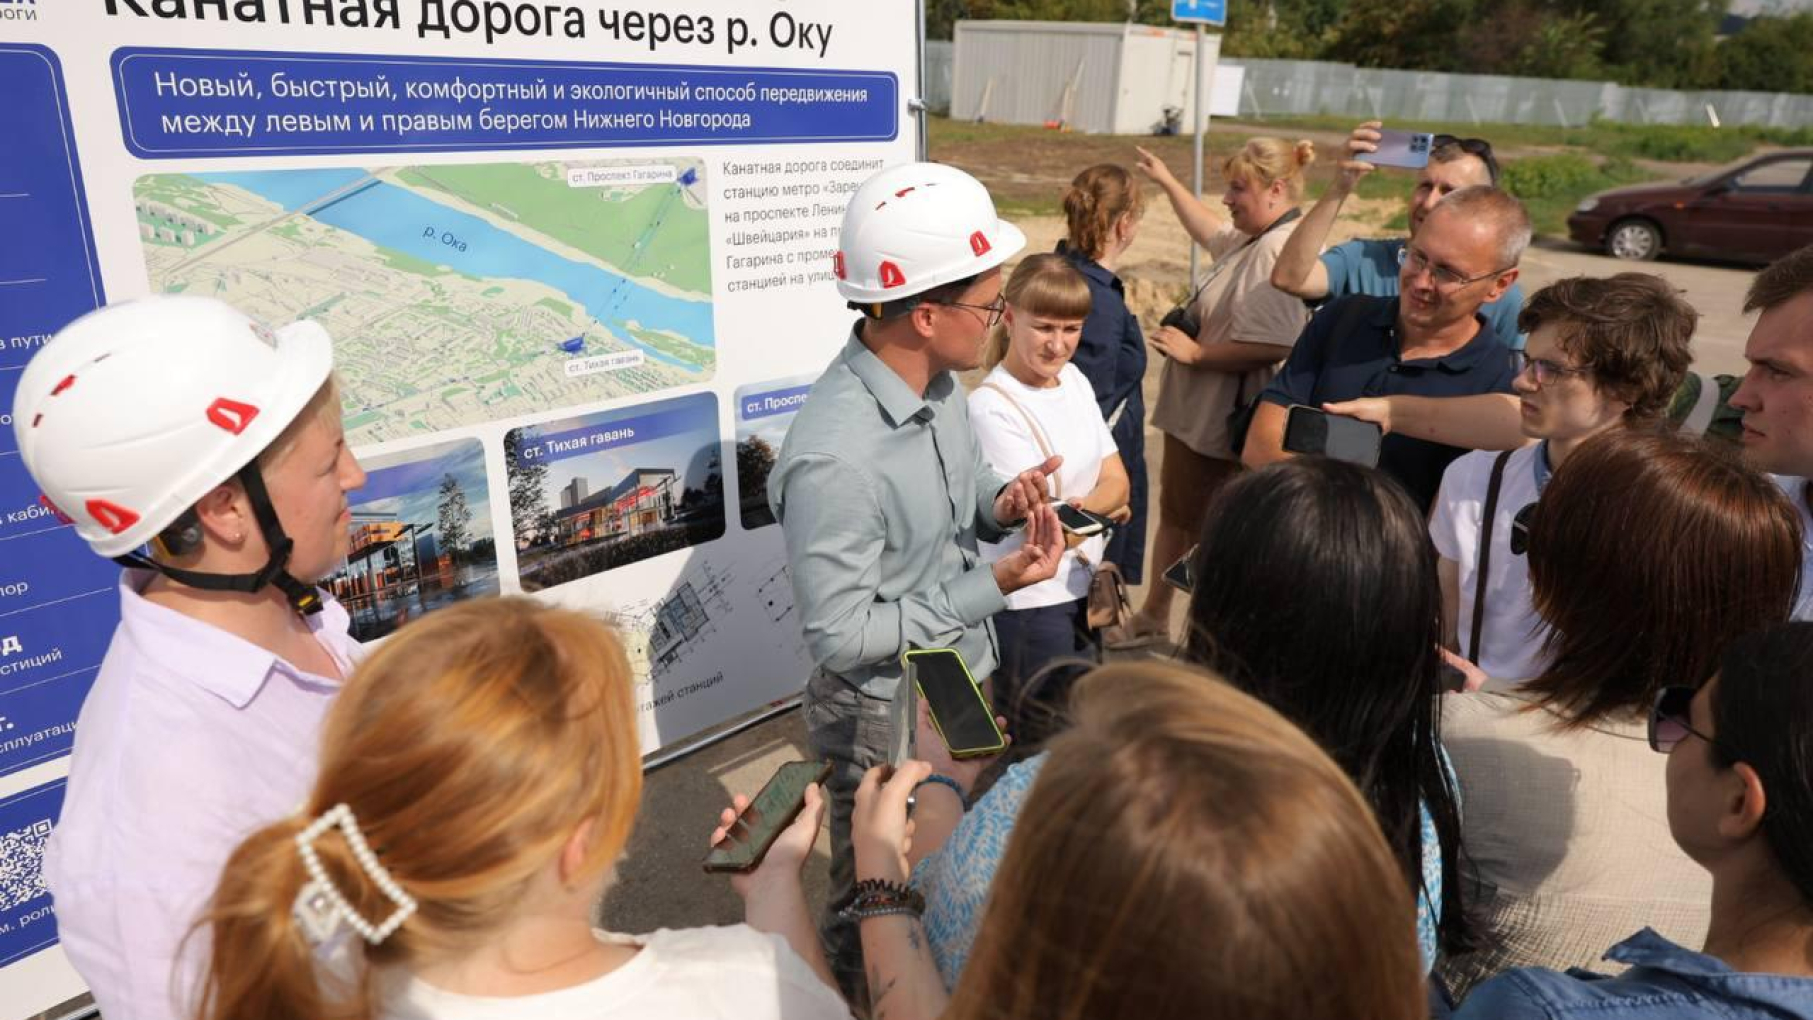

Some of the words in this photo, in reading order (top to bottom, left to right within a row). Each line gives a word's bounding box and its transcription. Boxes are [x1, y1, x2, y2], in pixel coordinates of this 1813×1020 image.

[0, 8, 38, 20] оги
[418, 0, 586, 44] дорога
[600, 9, 715, 50] через
[727, 16, 758, 54] р.
[769, 11, 833, 58] Оку
[154, 71, 263, 100] Новый,
[271, 72, 398, 102] быстрый,
[405, 76, 547, 103] комфортный
[554, 83, 565, 99] и
[571, 81, 691, 101] экологичный
[695, 81, 756, 102] способ
[760, 86, 869, 104] передвижения
[162, 113, 257, 138] между
[265, 113, 351, 133] левым
[359, 114, 375, 132] и
[382, 112, 473, 136] правым
[479, 107, 568, 133] берегом
[573, 109, 655, 130] Нижнего
[659, 109, 752, 131] Новгорода
[587, 171, 630, 183] Проспект
[632, 169, 673, 181] Гагарина
[723, 162, 781, 175] Канатная
[784, 161, 827, 175] дорога
[830, 158, 885, 171] соединит
[723, 185, 779, 200] станцию
[782, 183, 821, 198] метро
[725, 212, 740, 223] на
[743, 207, 810, 225] проспекте
[422, 226, 436, 239] р.
[441, 231, 467, 252] Ока
[726, 229, 810, 247] «Швейцария»
[813, 227, 828, 239] на
[726, 252, 784, 270] Гагарина
[787, 252, 794, 263] с
[727, 272, 787, 293] станцией
[790, 274, 804, 285] на
[747, 402, 763, 413] ст.
[523, 446, 544, 459] ст.
[545, 437, 588, 455] Тихая
[590, 427, 635, 446] гавань
[676, 671, 724, 698] станций
